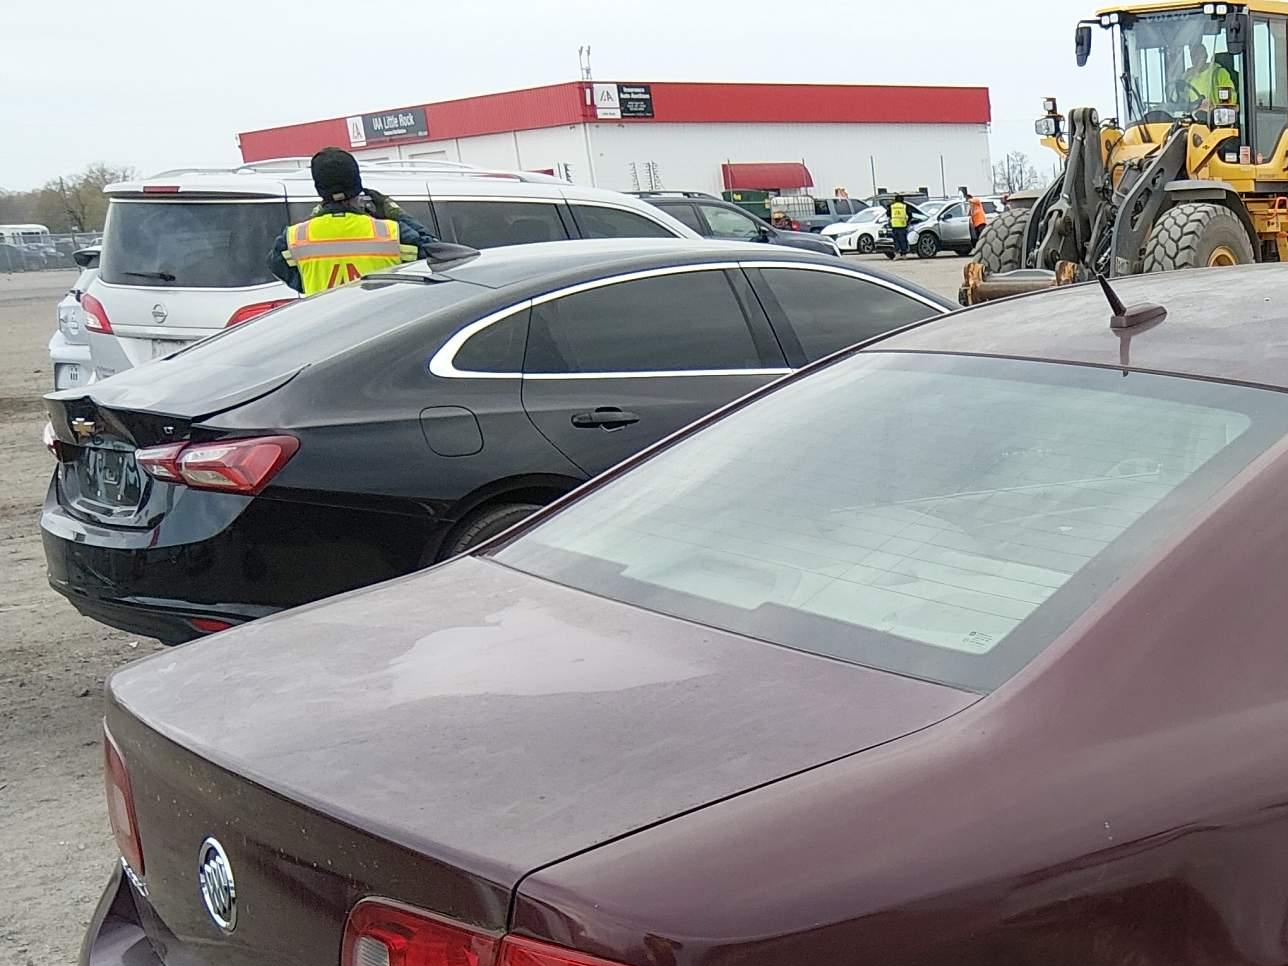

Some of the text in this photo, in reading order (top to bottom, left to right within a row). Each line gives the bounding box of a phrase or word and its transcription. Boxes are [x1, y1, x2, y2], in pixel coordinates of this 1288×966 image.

[383, 114, 399, 129] Little
[399, 112, 415, 127] Rock
[163, 426, 175, 435] LT
